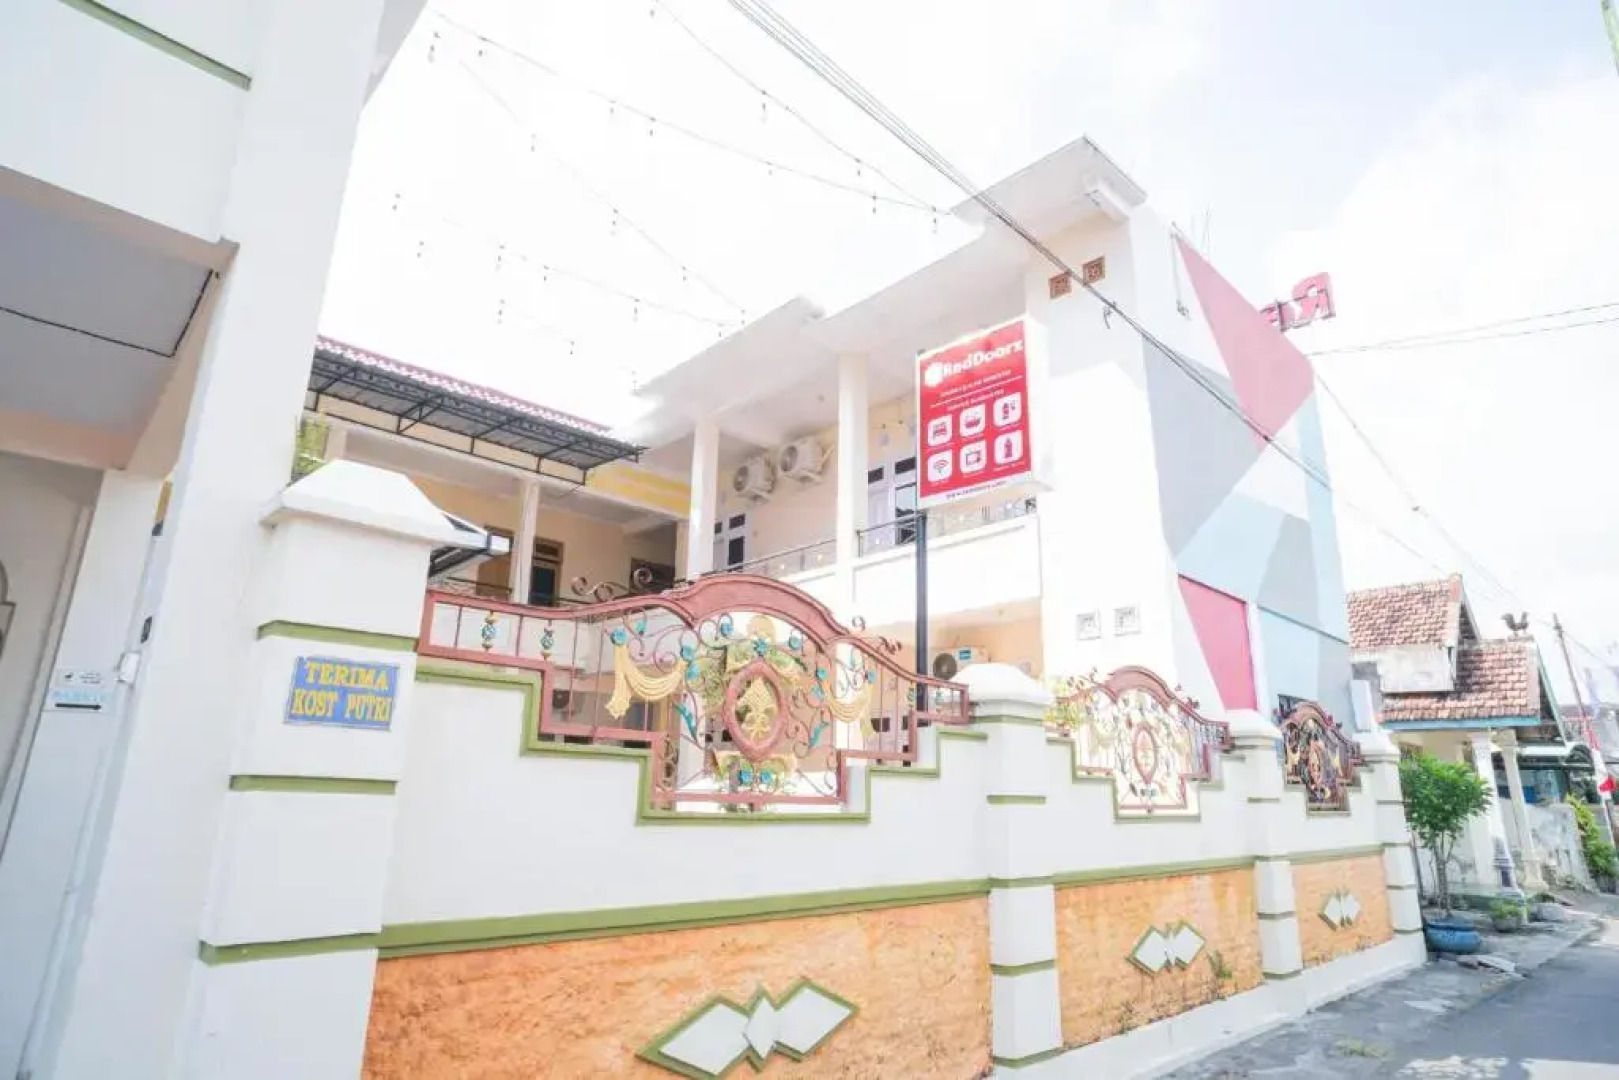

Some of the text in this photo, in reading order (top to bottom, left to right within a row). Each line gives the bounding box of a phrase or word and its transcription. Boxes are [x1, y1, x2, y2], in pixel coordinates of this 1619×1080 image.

[305, 661, 389, 690] TERIMA
[290, 688, 391, 722] KOST PUTRI
